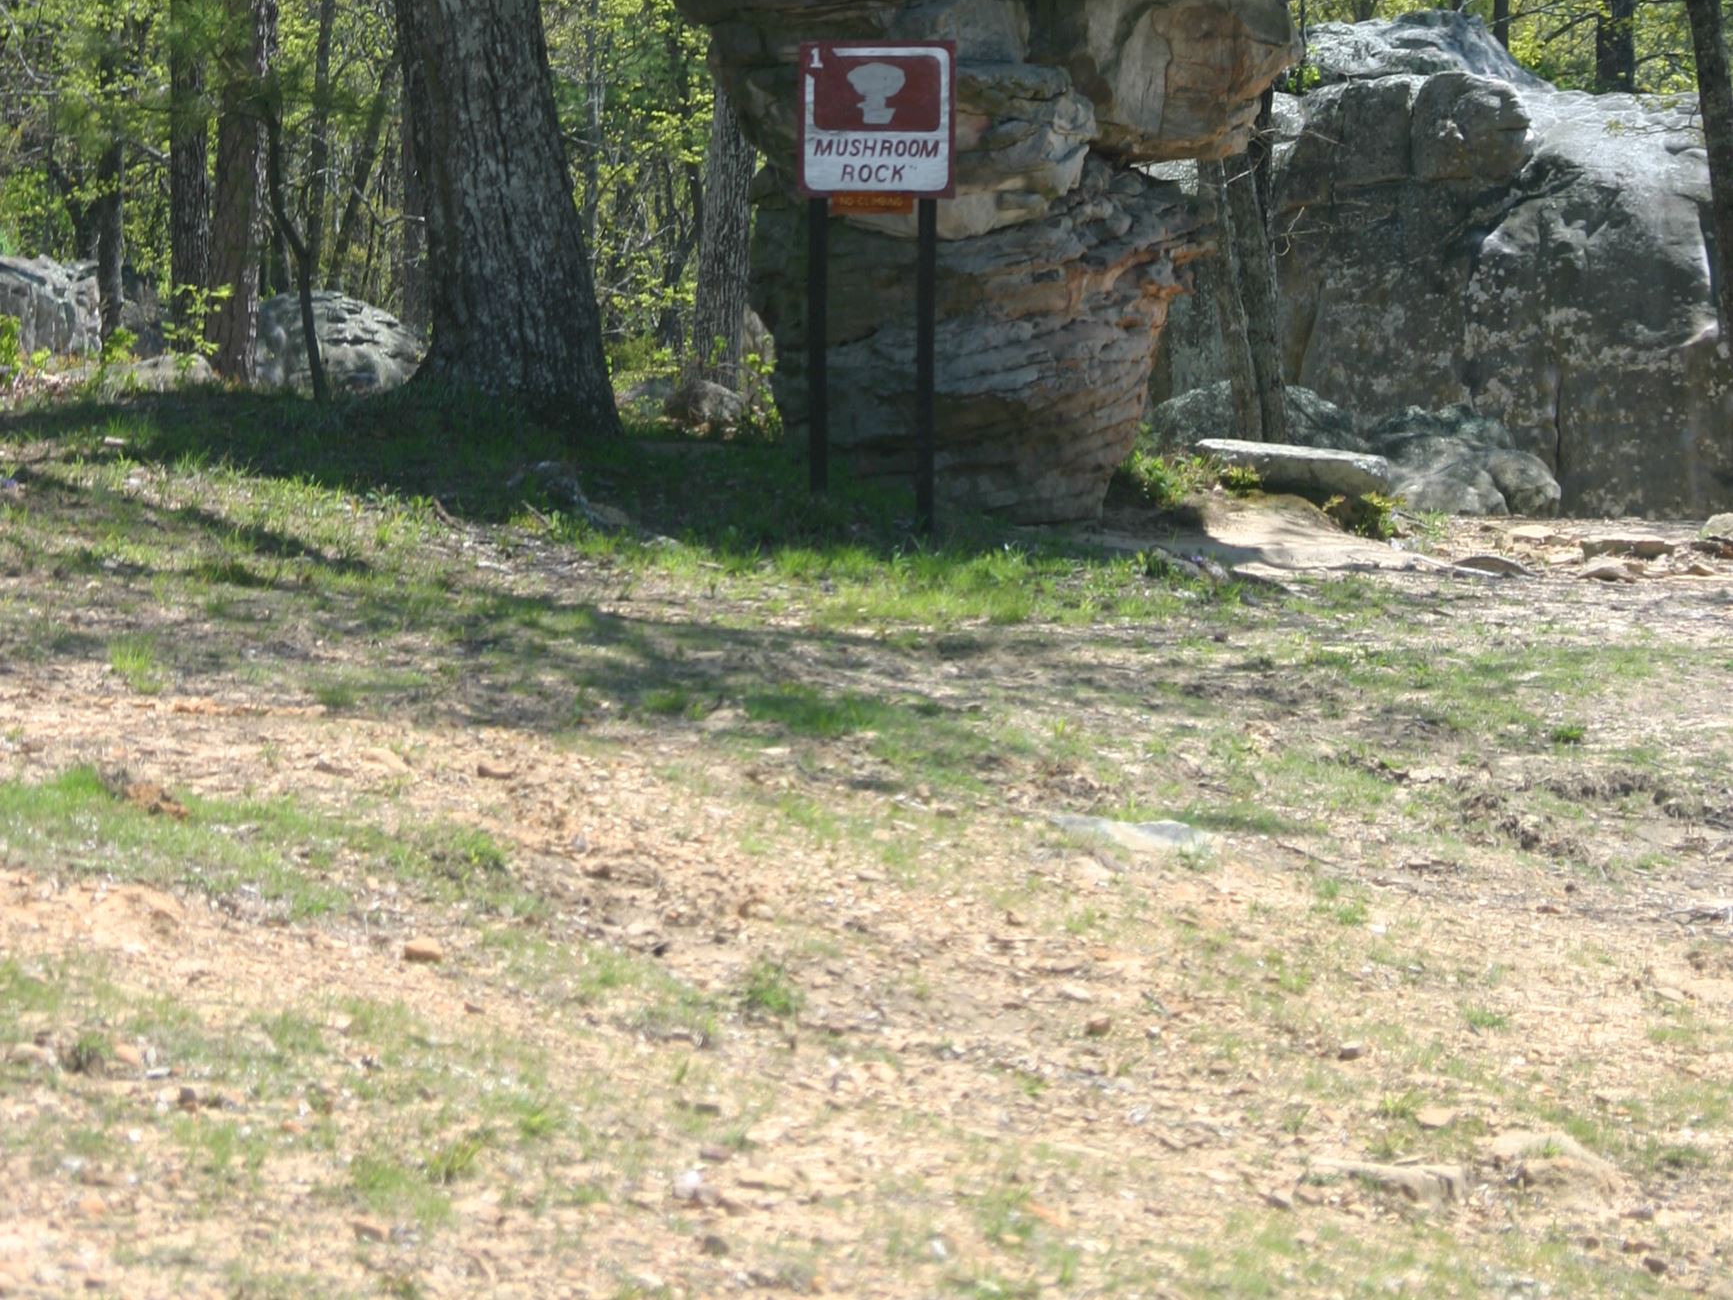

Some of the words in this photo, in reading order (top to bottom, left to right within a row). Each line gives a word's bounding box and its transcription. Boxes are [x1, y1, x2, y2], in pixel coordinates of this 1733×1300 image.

[810, 47, 823, 68] 1
[813, 138, 940, 158] MUSHROOM
[840, 163, 906, 183] ROCK
[839, 196, 854, 206] NO
